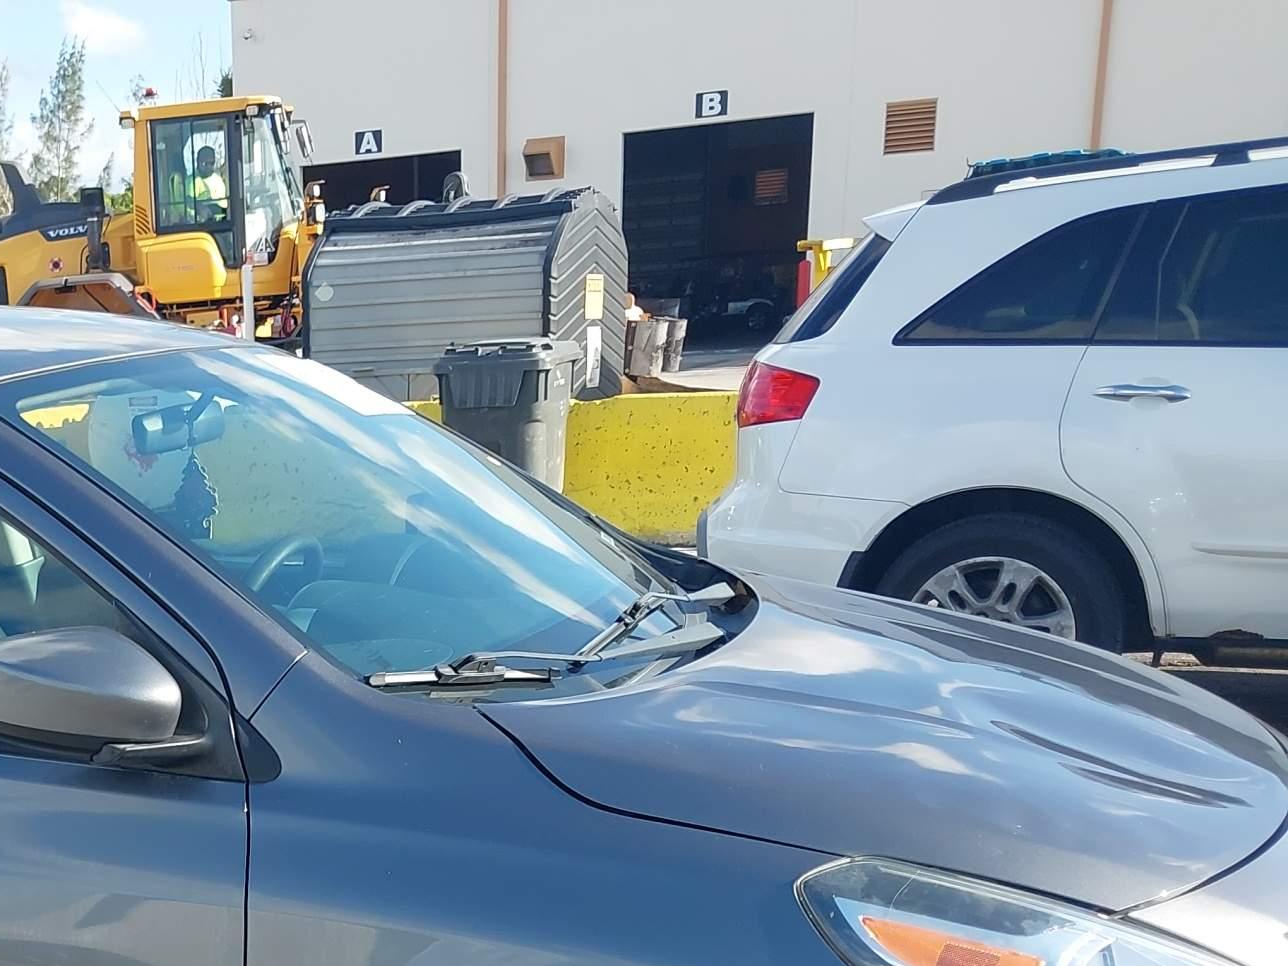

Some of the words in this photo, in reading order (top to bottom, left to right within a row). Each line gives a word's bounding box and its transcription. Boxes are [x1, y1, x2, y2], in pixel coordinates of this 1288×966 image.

[702, 93, 722, 116] B
[359, 132, 378, 153] A
[47, 225, 88, 238] VOLV
